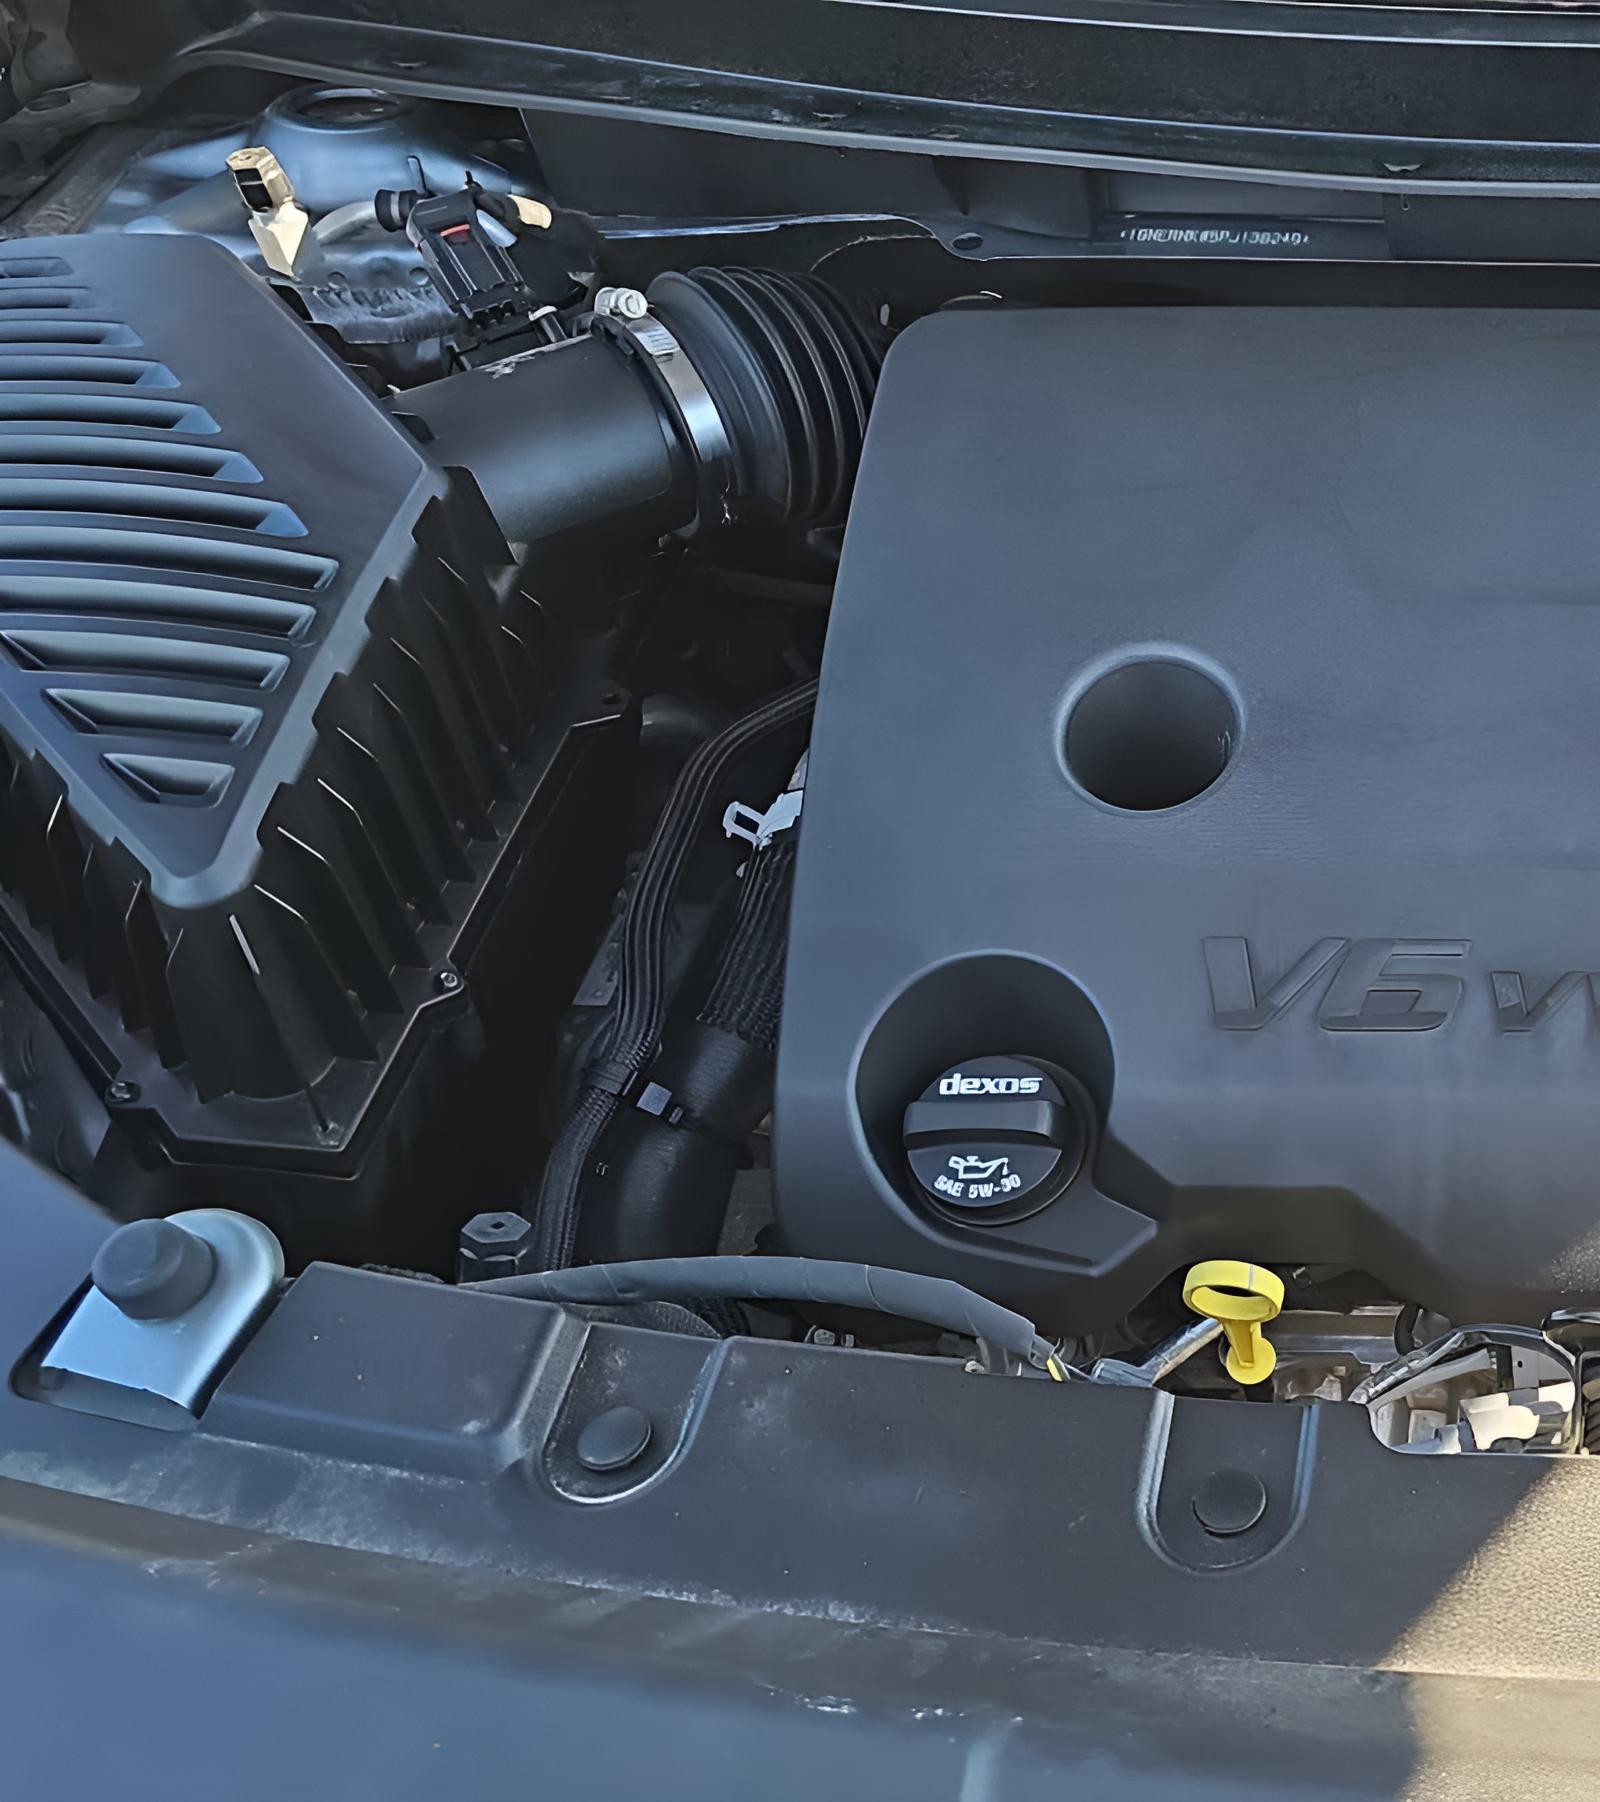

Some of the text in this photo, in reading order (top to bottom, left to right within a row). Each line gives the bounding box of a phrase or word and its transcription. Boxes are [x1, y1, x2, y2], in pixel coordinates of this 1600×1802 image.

[1201, 936, 1472, 1032] V6
[939, 1073, 1043, 1095] dexos
[934, 1174, 1022, 1199] SAE 5W-30
